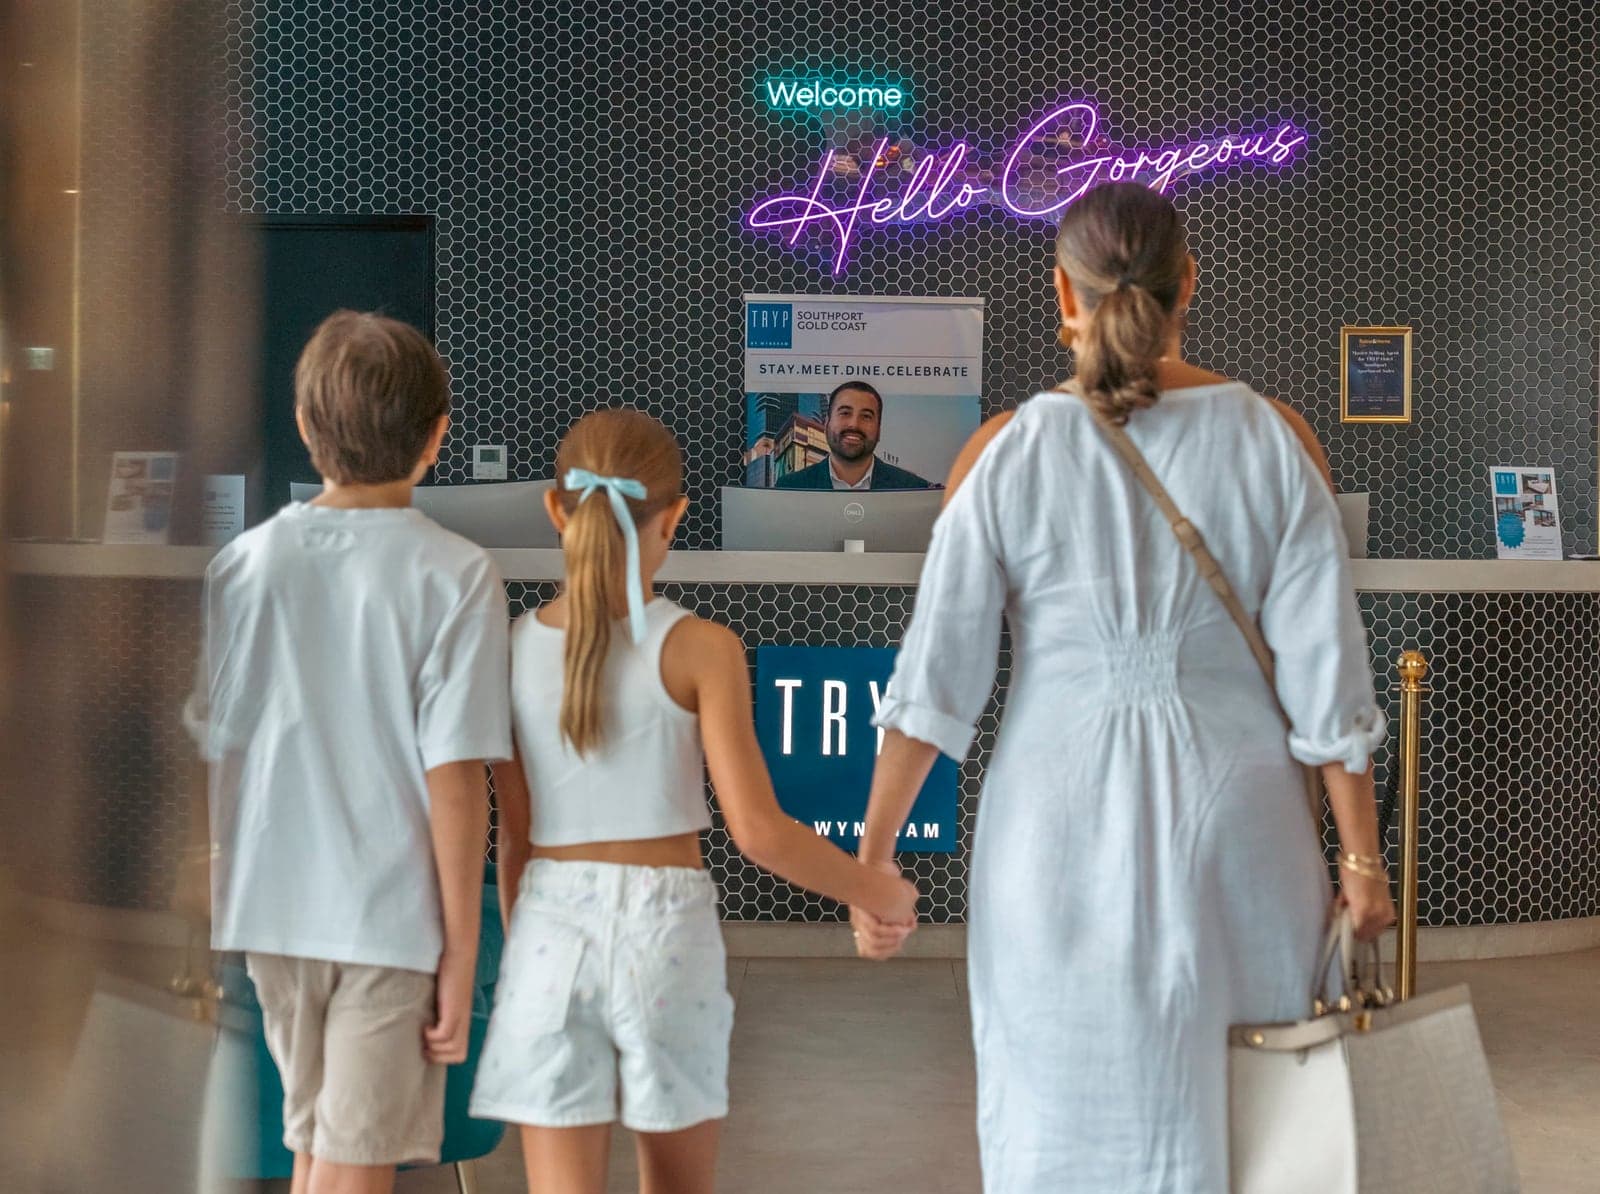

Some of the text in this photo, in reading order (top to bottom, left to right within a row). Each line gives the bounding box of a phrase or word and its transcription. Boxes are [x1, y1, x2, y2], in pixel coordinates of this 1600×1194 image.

[767, 80, 902, 108] Welcome
[749, 102, 1305, 275] Hello Gorgeous
[751, 310, 789, 328] TRYP
[797, 310, 864, 321] SOUTHPORT
[797, 321, 868, 331] GOLD COAST
[759, 363, 969, 377] STAY.MEET.DINE.CELEBRATE
[775, 679, 891, 756] TRY
[814, 820, 939, 838] WYNAM
